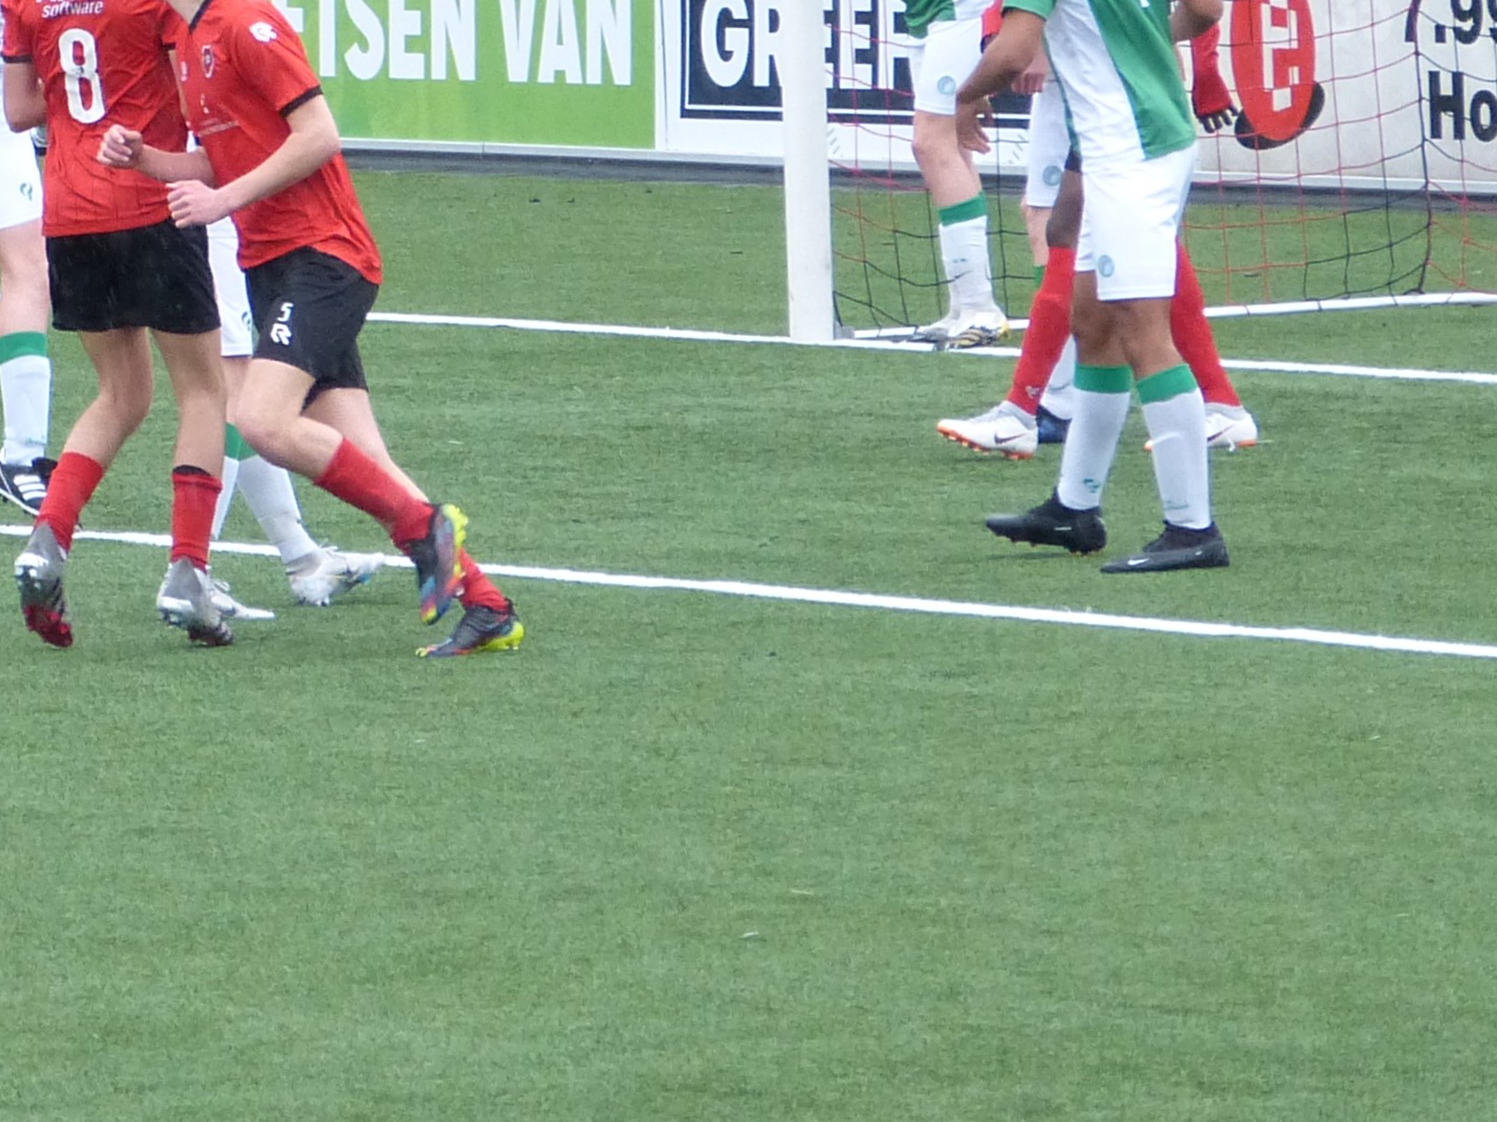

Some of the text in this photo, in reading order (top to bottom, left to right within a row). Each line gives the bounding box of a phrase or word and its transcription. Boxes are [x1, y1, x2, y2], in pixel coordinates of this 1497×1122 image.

[41, 0, 104, 19] software
[58, 27, 106, 124] 8
[276, 301, 295, 323] 5
